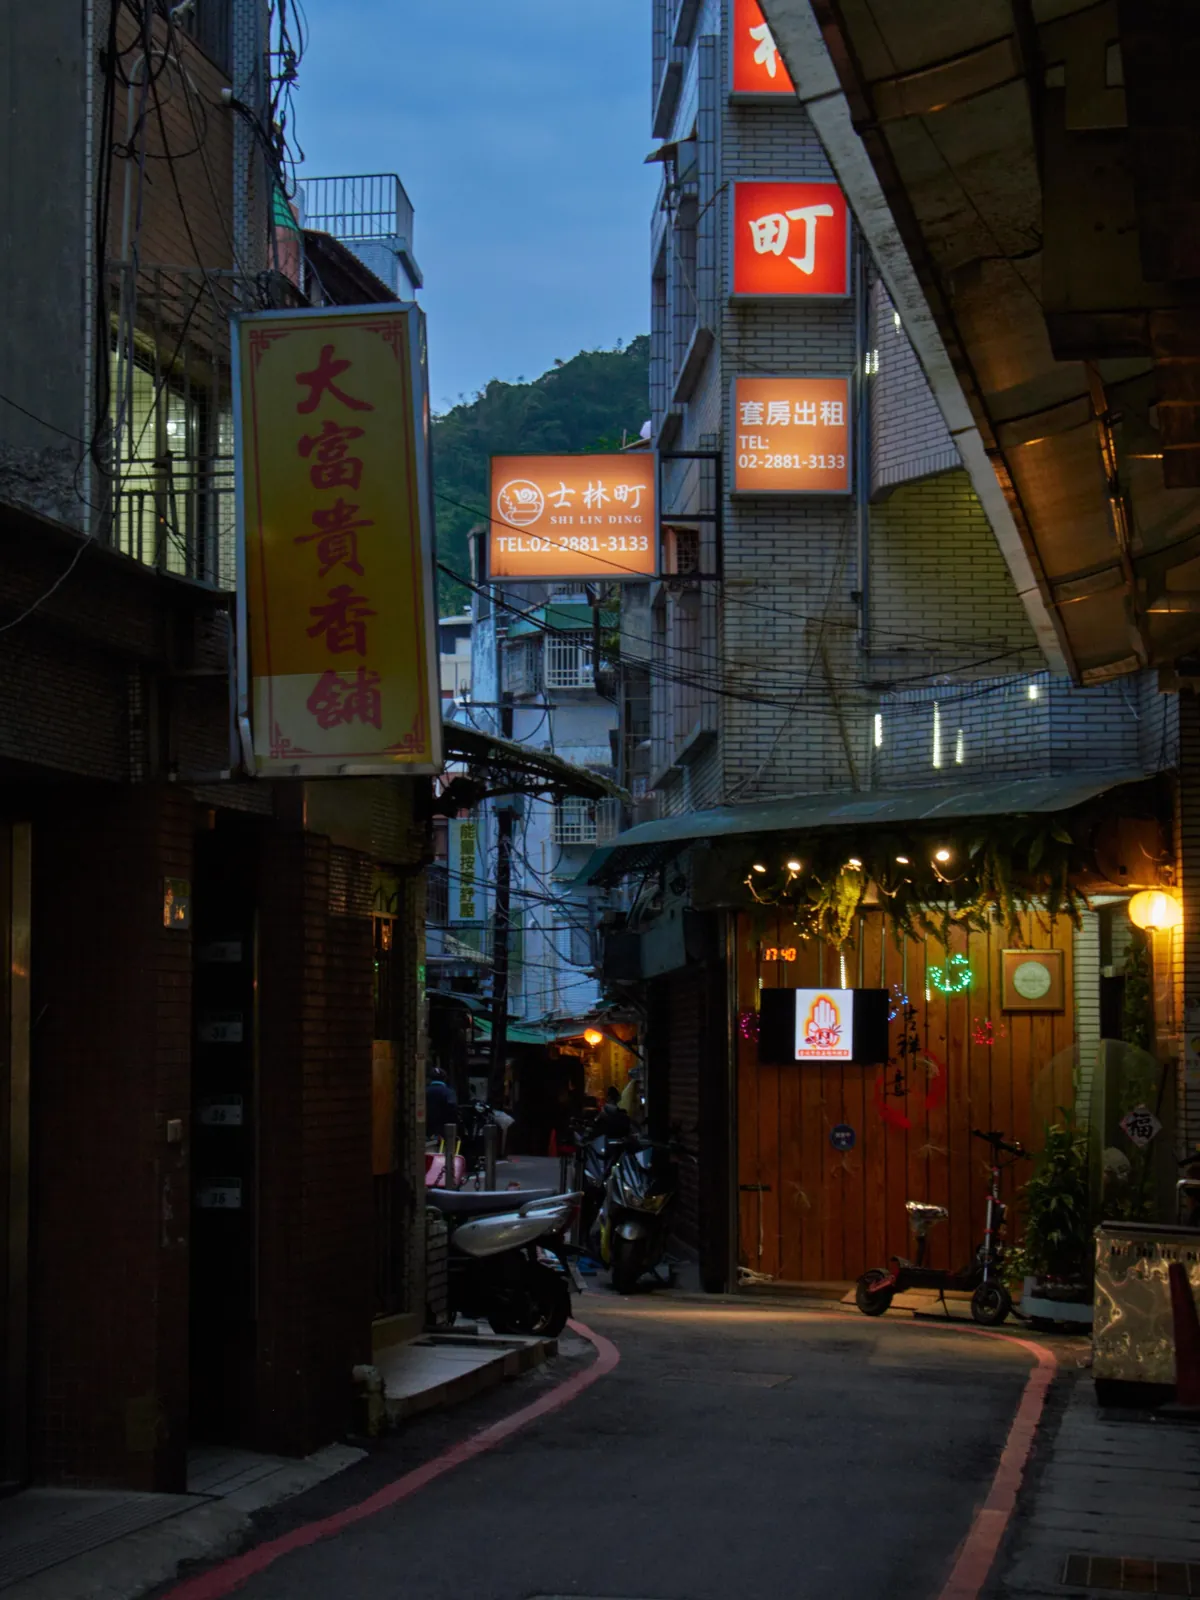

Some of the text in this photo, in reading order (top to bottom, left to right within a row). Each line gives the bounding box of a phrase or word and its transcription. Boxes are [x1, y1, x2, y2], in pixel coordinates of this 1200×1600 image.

[748, 204, 834, 275] 町
[740, 400, 844, 426] 套房出租
[739, 435, 769, 449] TEL:
[738, 454, 845, 469] 02-2881-3133
[548, 479, 646, 509] 士林町
[550, 515, 643, 525] SHI LIN DING
[497, 535, 648, 553] TEL:02-2881-3133
[1126, 1112, 1155, 1140] 福
